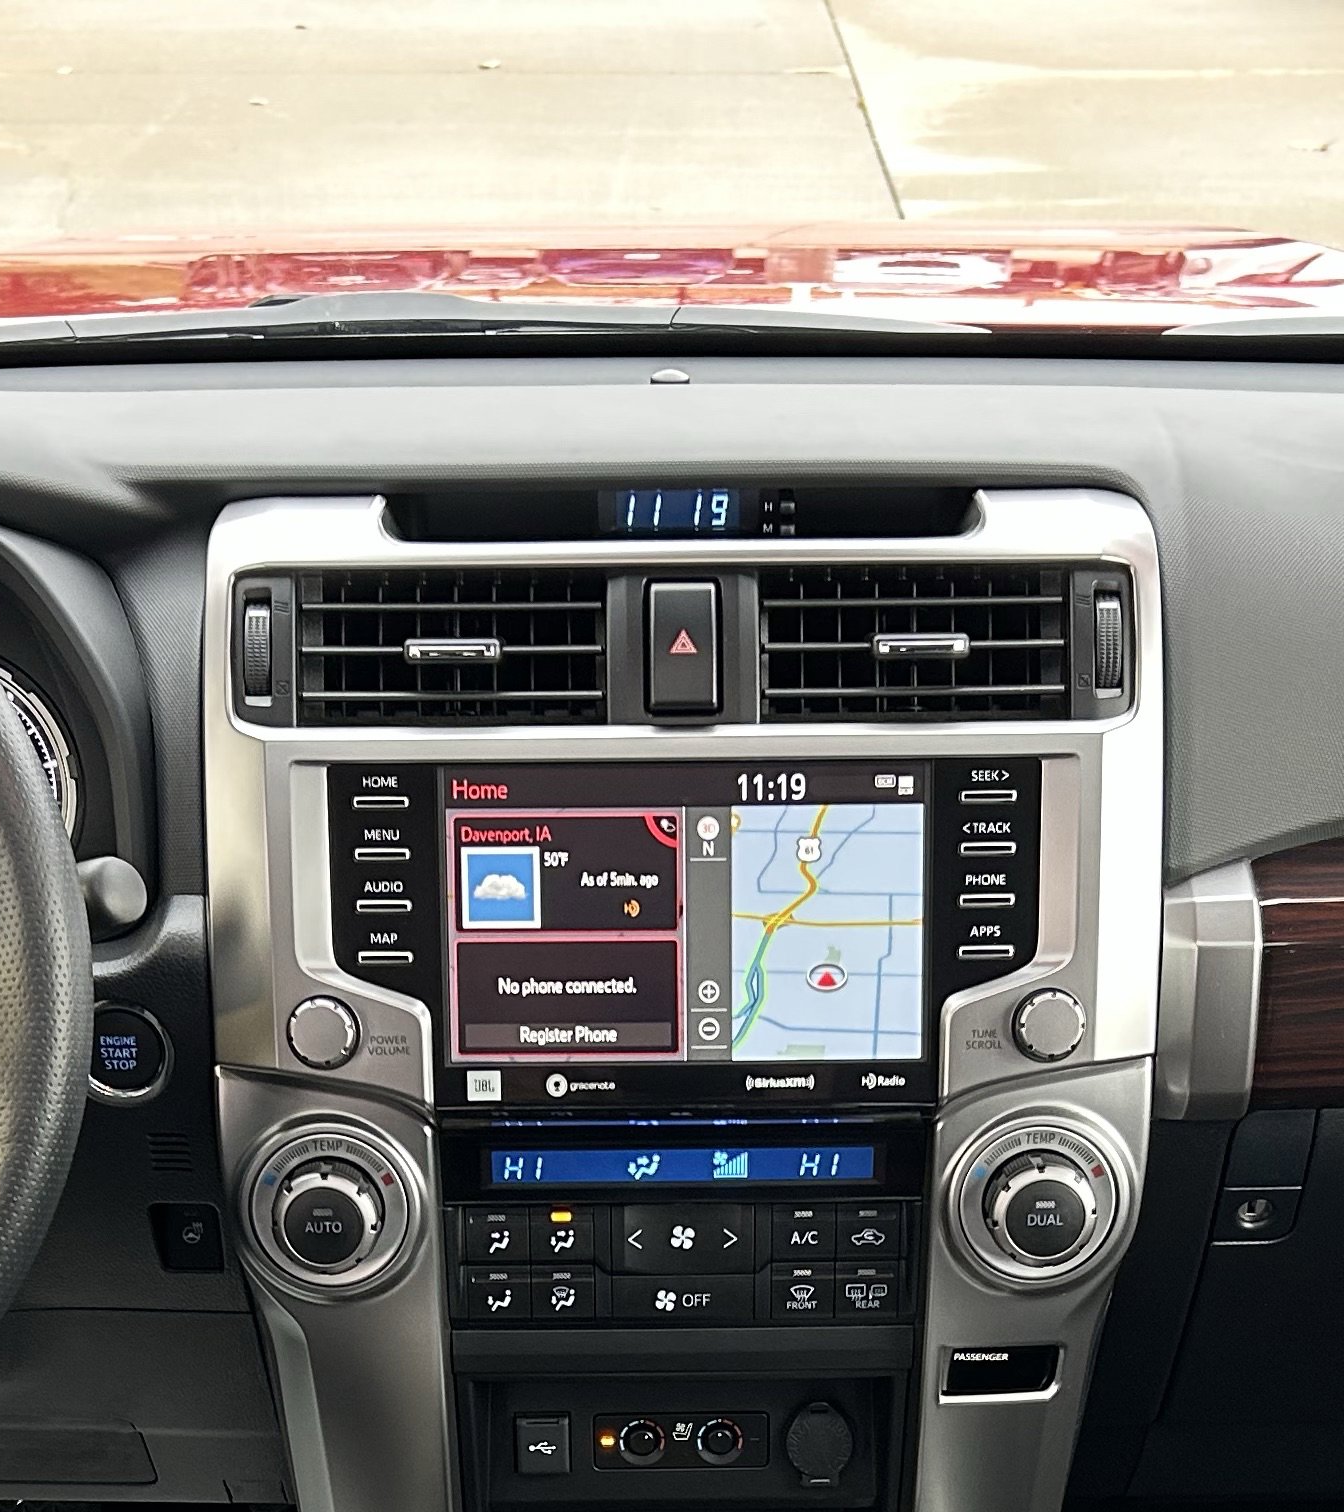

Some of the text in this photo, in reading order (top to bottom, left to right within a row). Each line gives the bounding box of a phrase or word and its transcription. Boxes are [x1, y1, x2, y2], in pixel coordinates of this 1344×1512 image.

[362, 776, 398, 788] HOME
[737, 773, 806, 801] 11:19
[452, 779, 508, 800] Home
[364, 829, 400, 841] MENU
[460, 826, 552, 844] Davenport, IA
[702, 840, 715, 857] N
[581, 872, 659, 889] As of 5min. ago
[965, 874, 1006, 886] PHONE
[364, 881, 403, 893] AUDIO
[970, 925, 1001, 937] APPS
[370, 933, 398, 944] MAP
[497, 976, 638, 997] No phone connected.
[520, 1025, 618, 1046] Register Phone
[971, 1029, 998, 1039] TUNE
[100, 1036, 137, 1046] ENGINE
[370, 1036, 407, 1046] POWER
[966, 1040, 1002, 1050] SCROLL
[100, 1048, 138, 1058] START
[368, 1046, 411, 1056] VOLUME
[104, 1060, 137, 1070] STOP
[474, 1079, 496, 1092] JBL
[878, 1075, 906, 1087] Radio
[1025, 1132, 1056, 1145] TEMP
[312, 1140, 343, 1153] TEMP
[1027, 1213, 1063, 1227] DUAL
[305, 1221, 342, 1234] AUTO
[790, 1231, 818, 1245] A/C
[682, 1293, 711, 1307] OFF
[786, 1301, 818, 1309] FRONT
[855, 1300, 880, 1309] REAR
[953, 1352, 1008, 1361] PASSENGER
